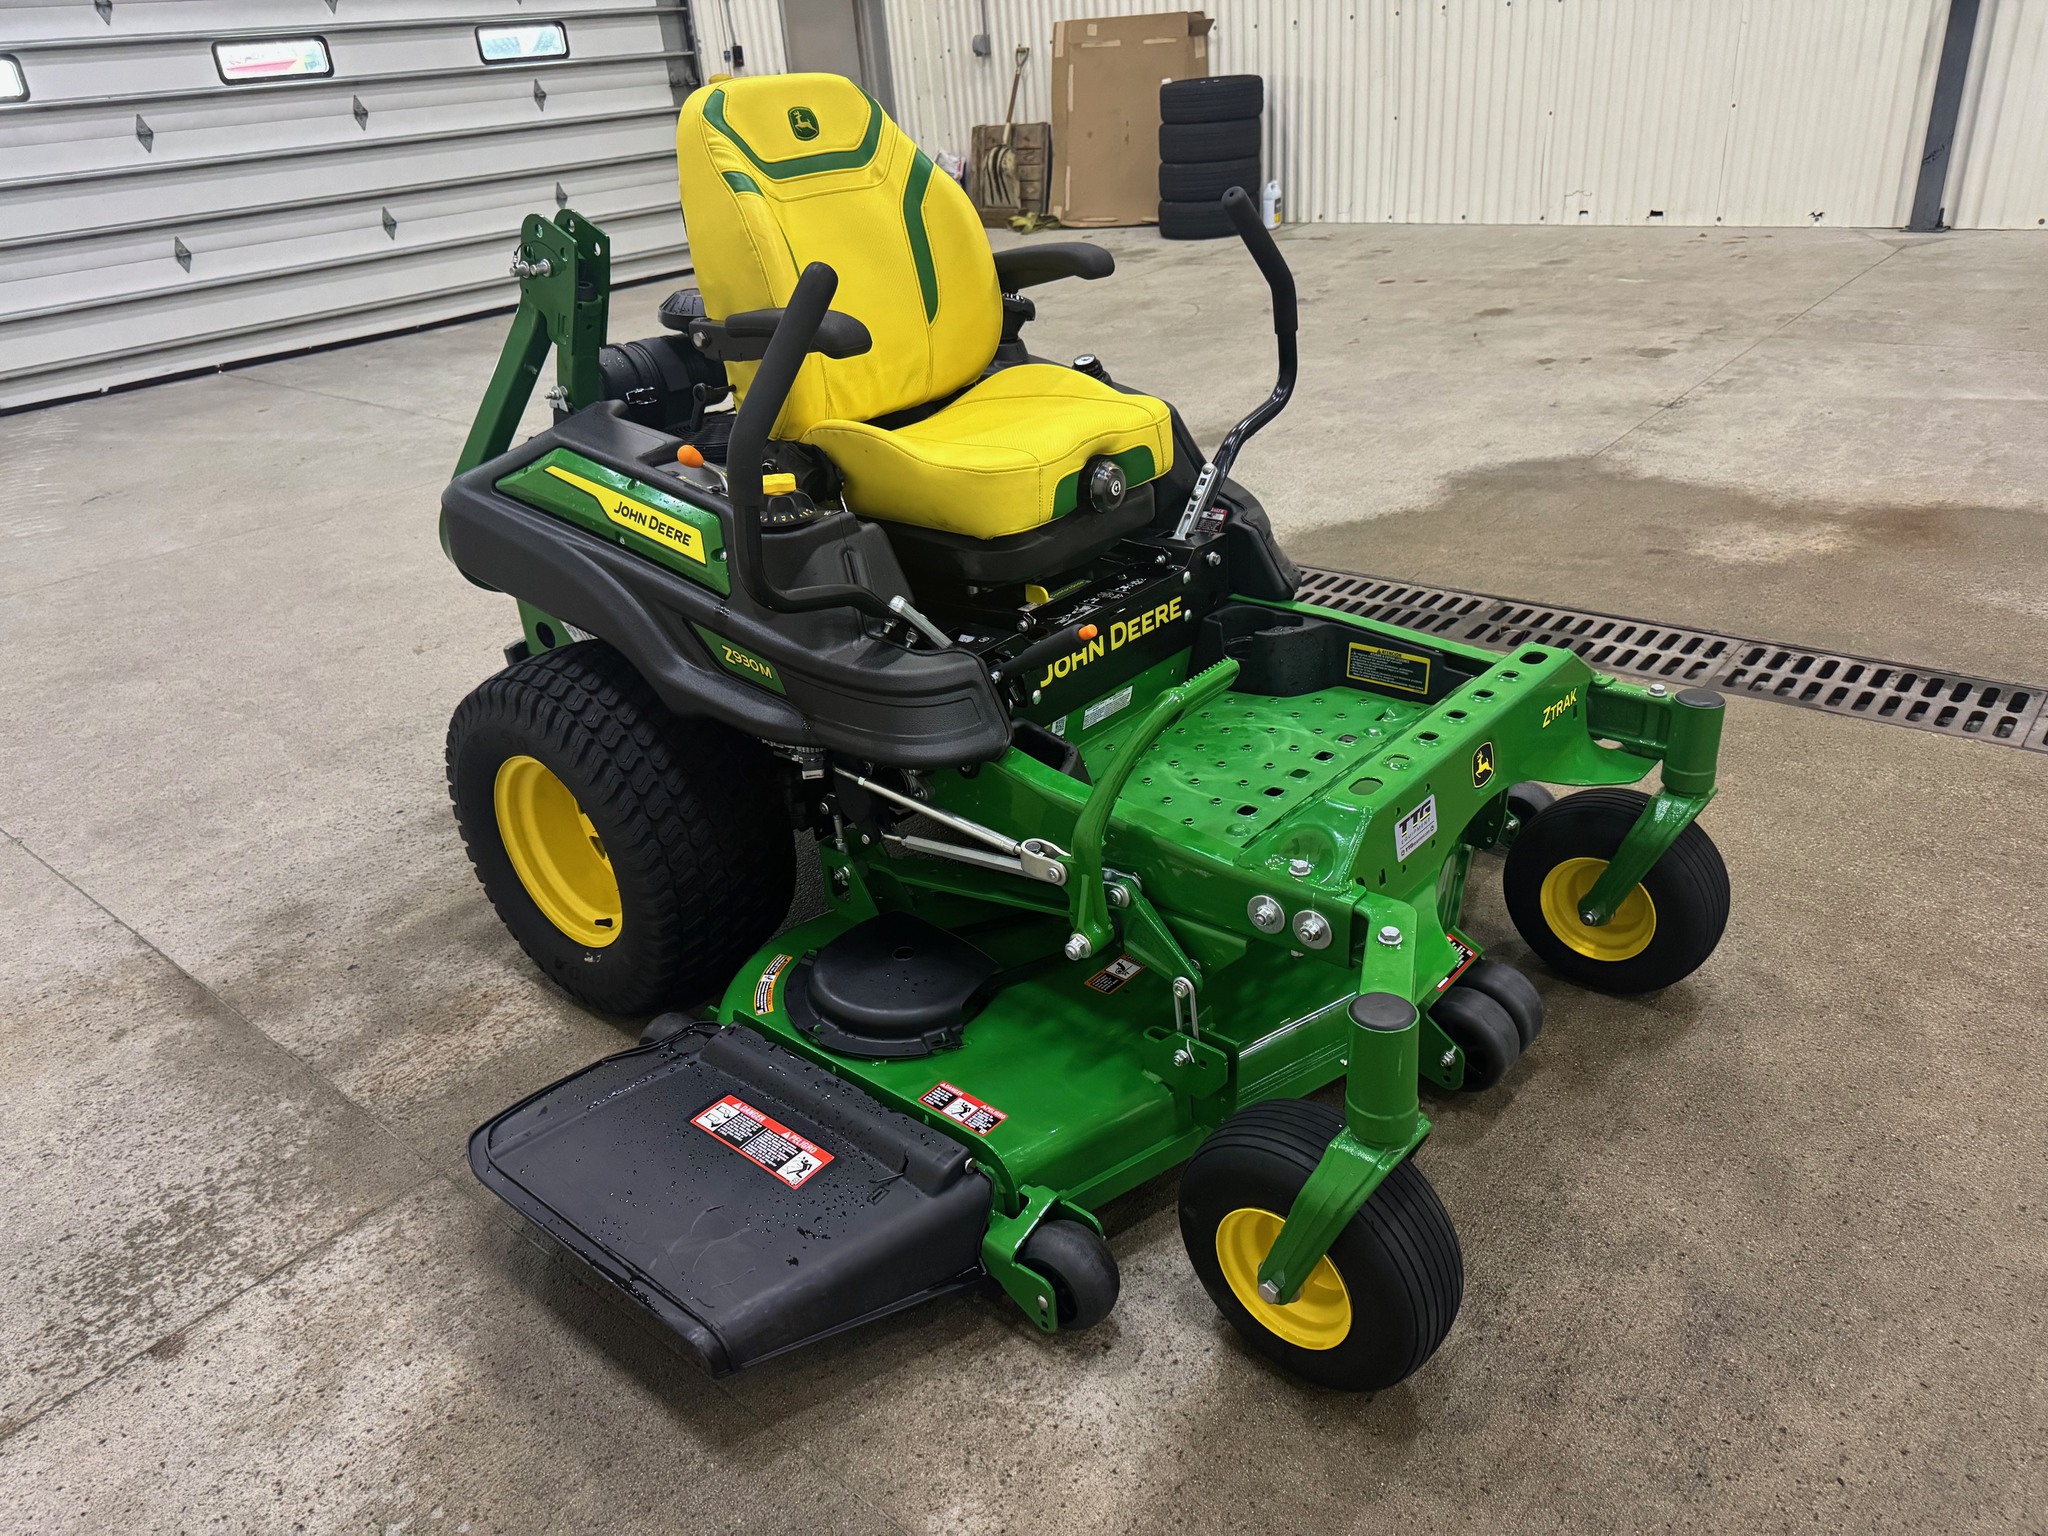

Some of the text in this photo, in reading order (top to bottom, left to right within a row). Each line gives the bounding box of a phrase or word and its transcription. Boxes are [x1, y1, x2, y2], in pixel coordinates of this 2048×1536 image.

[613, 501, 692, 546] JOHN DEERE
[1040, 635, 1105, 688] JOHN
[1110, 596, 1182, 651] DEERE
[1542, 687, 1578, 729] ZTRAK
[1399, 799, 1431, 838] TTG
[739, 1105, 767, 1123] DANGER
[788, 1134, 818, 1154] PELIGRO
